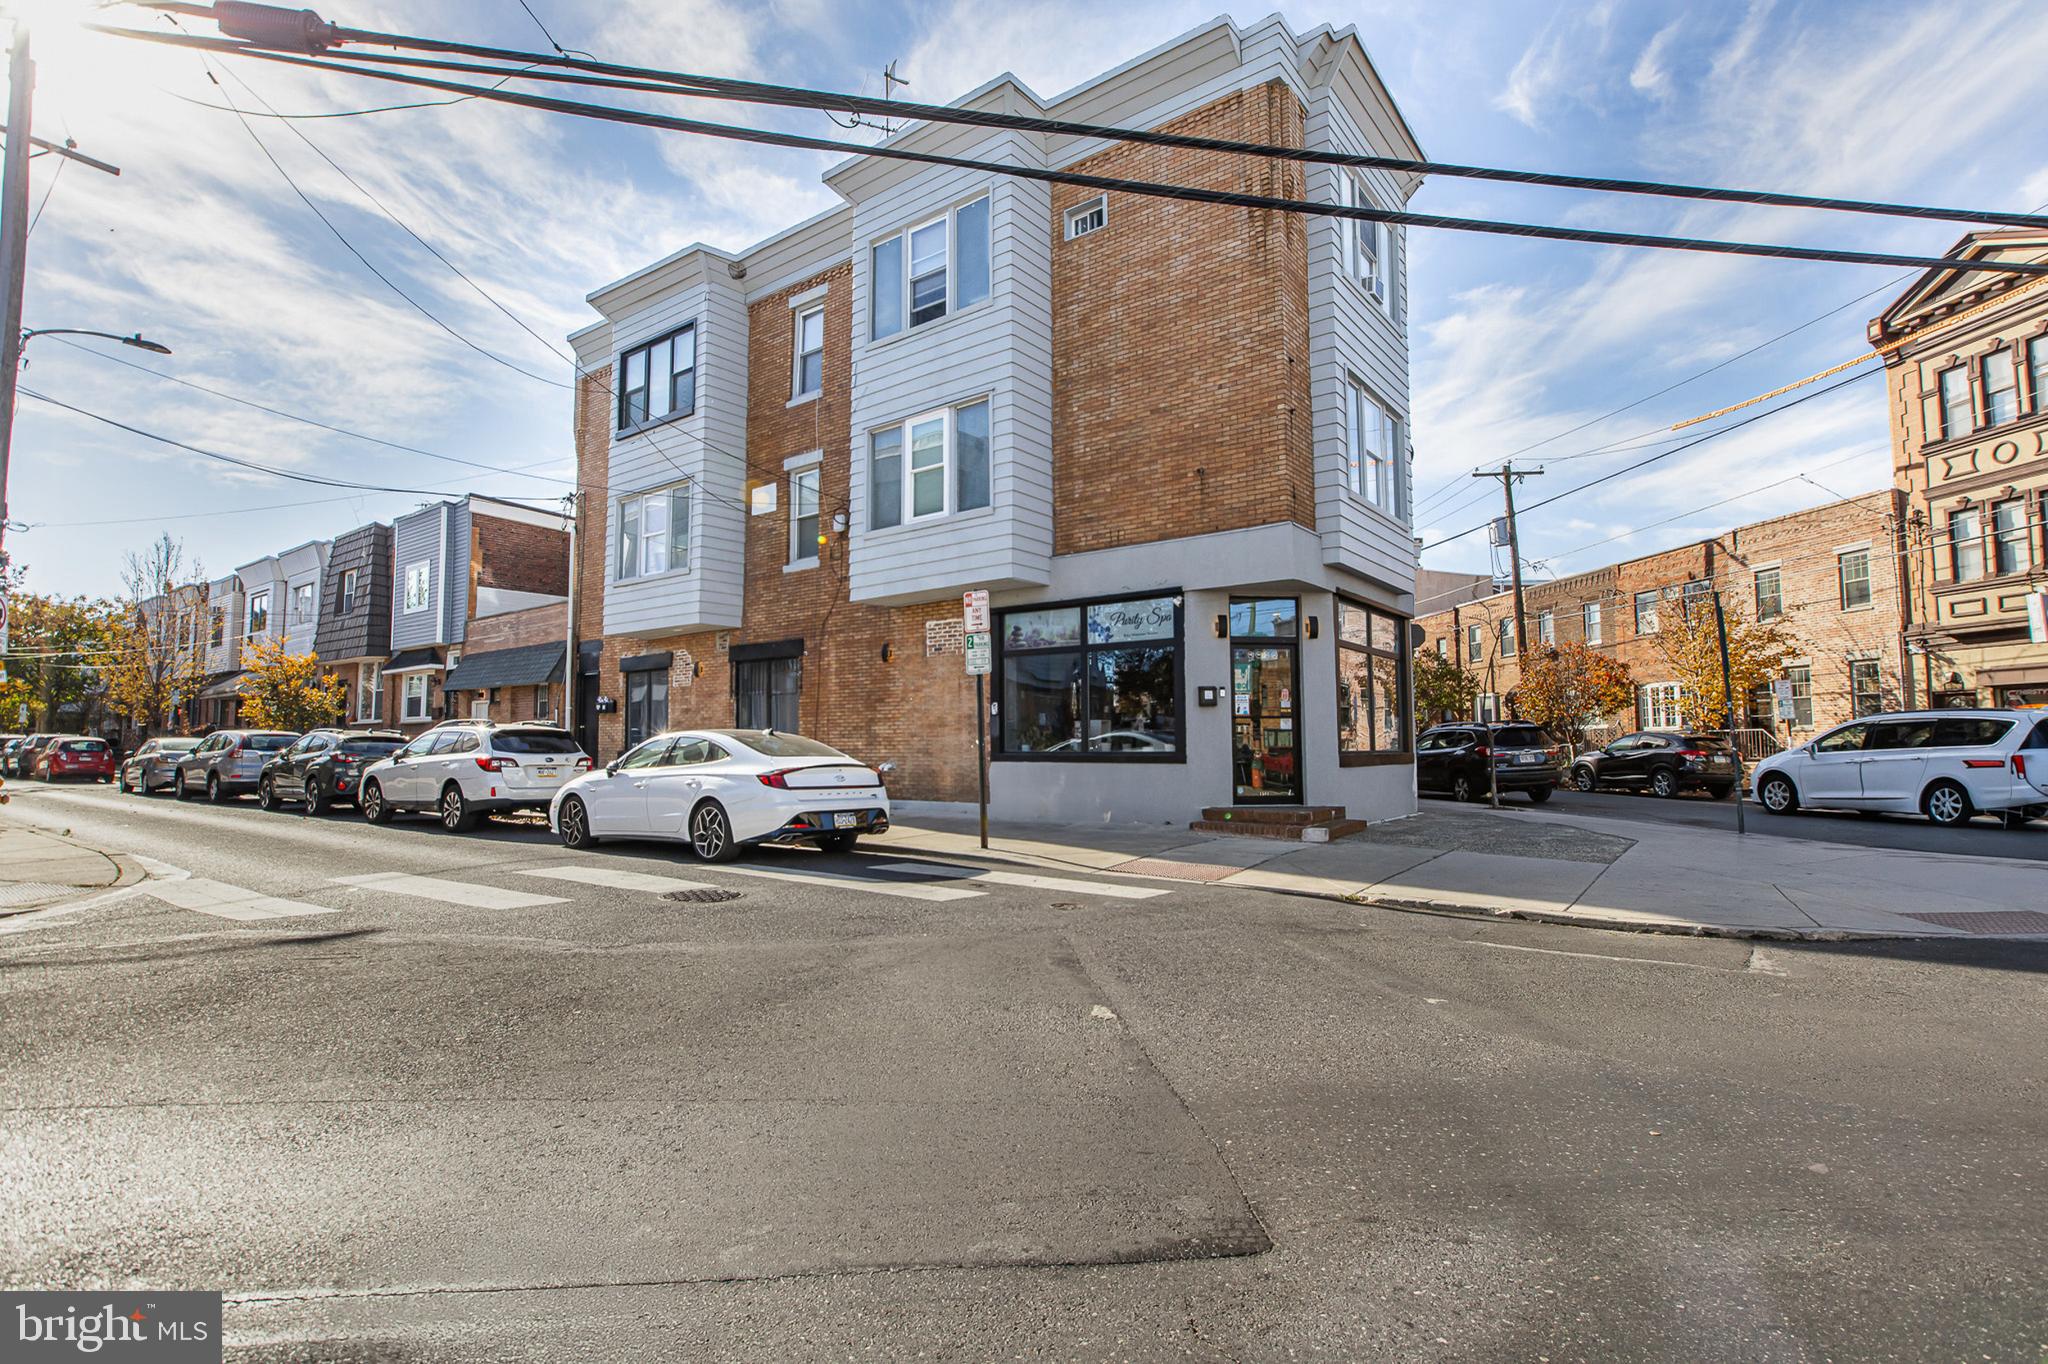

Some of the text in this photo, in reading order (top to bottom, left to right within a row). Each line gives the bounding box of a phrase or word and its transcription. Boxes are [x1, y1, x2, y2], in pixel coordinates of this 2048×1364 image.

[1110, 607, 1172, 629] Purity Spa
[967, 637, 973, 648] 2
